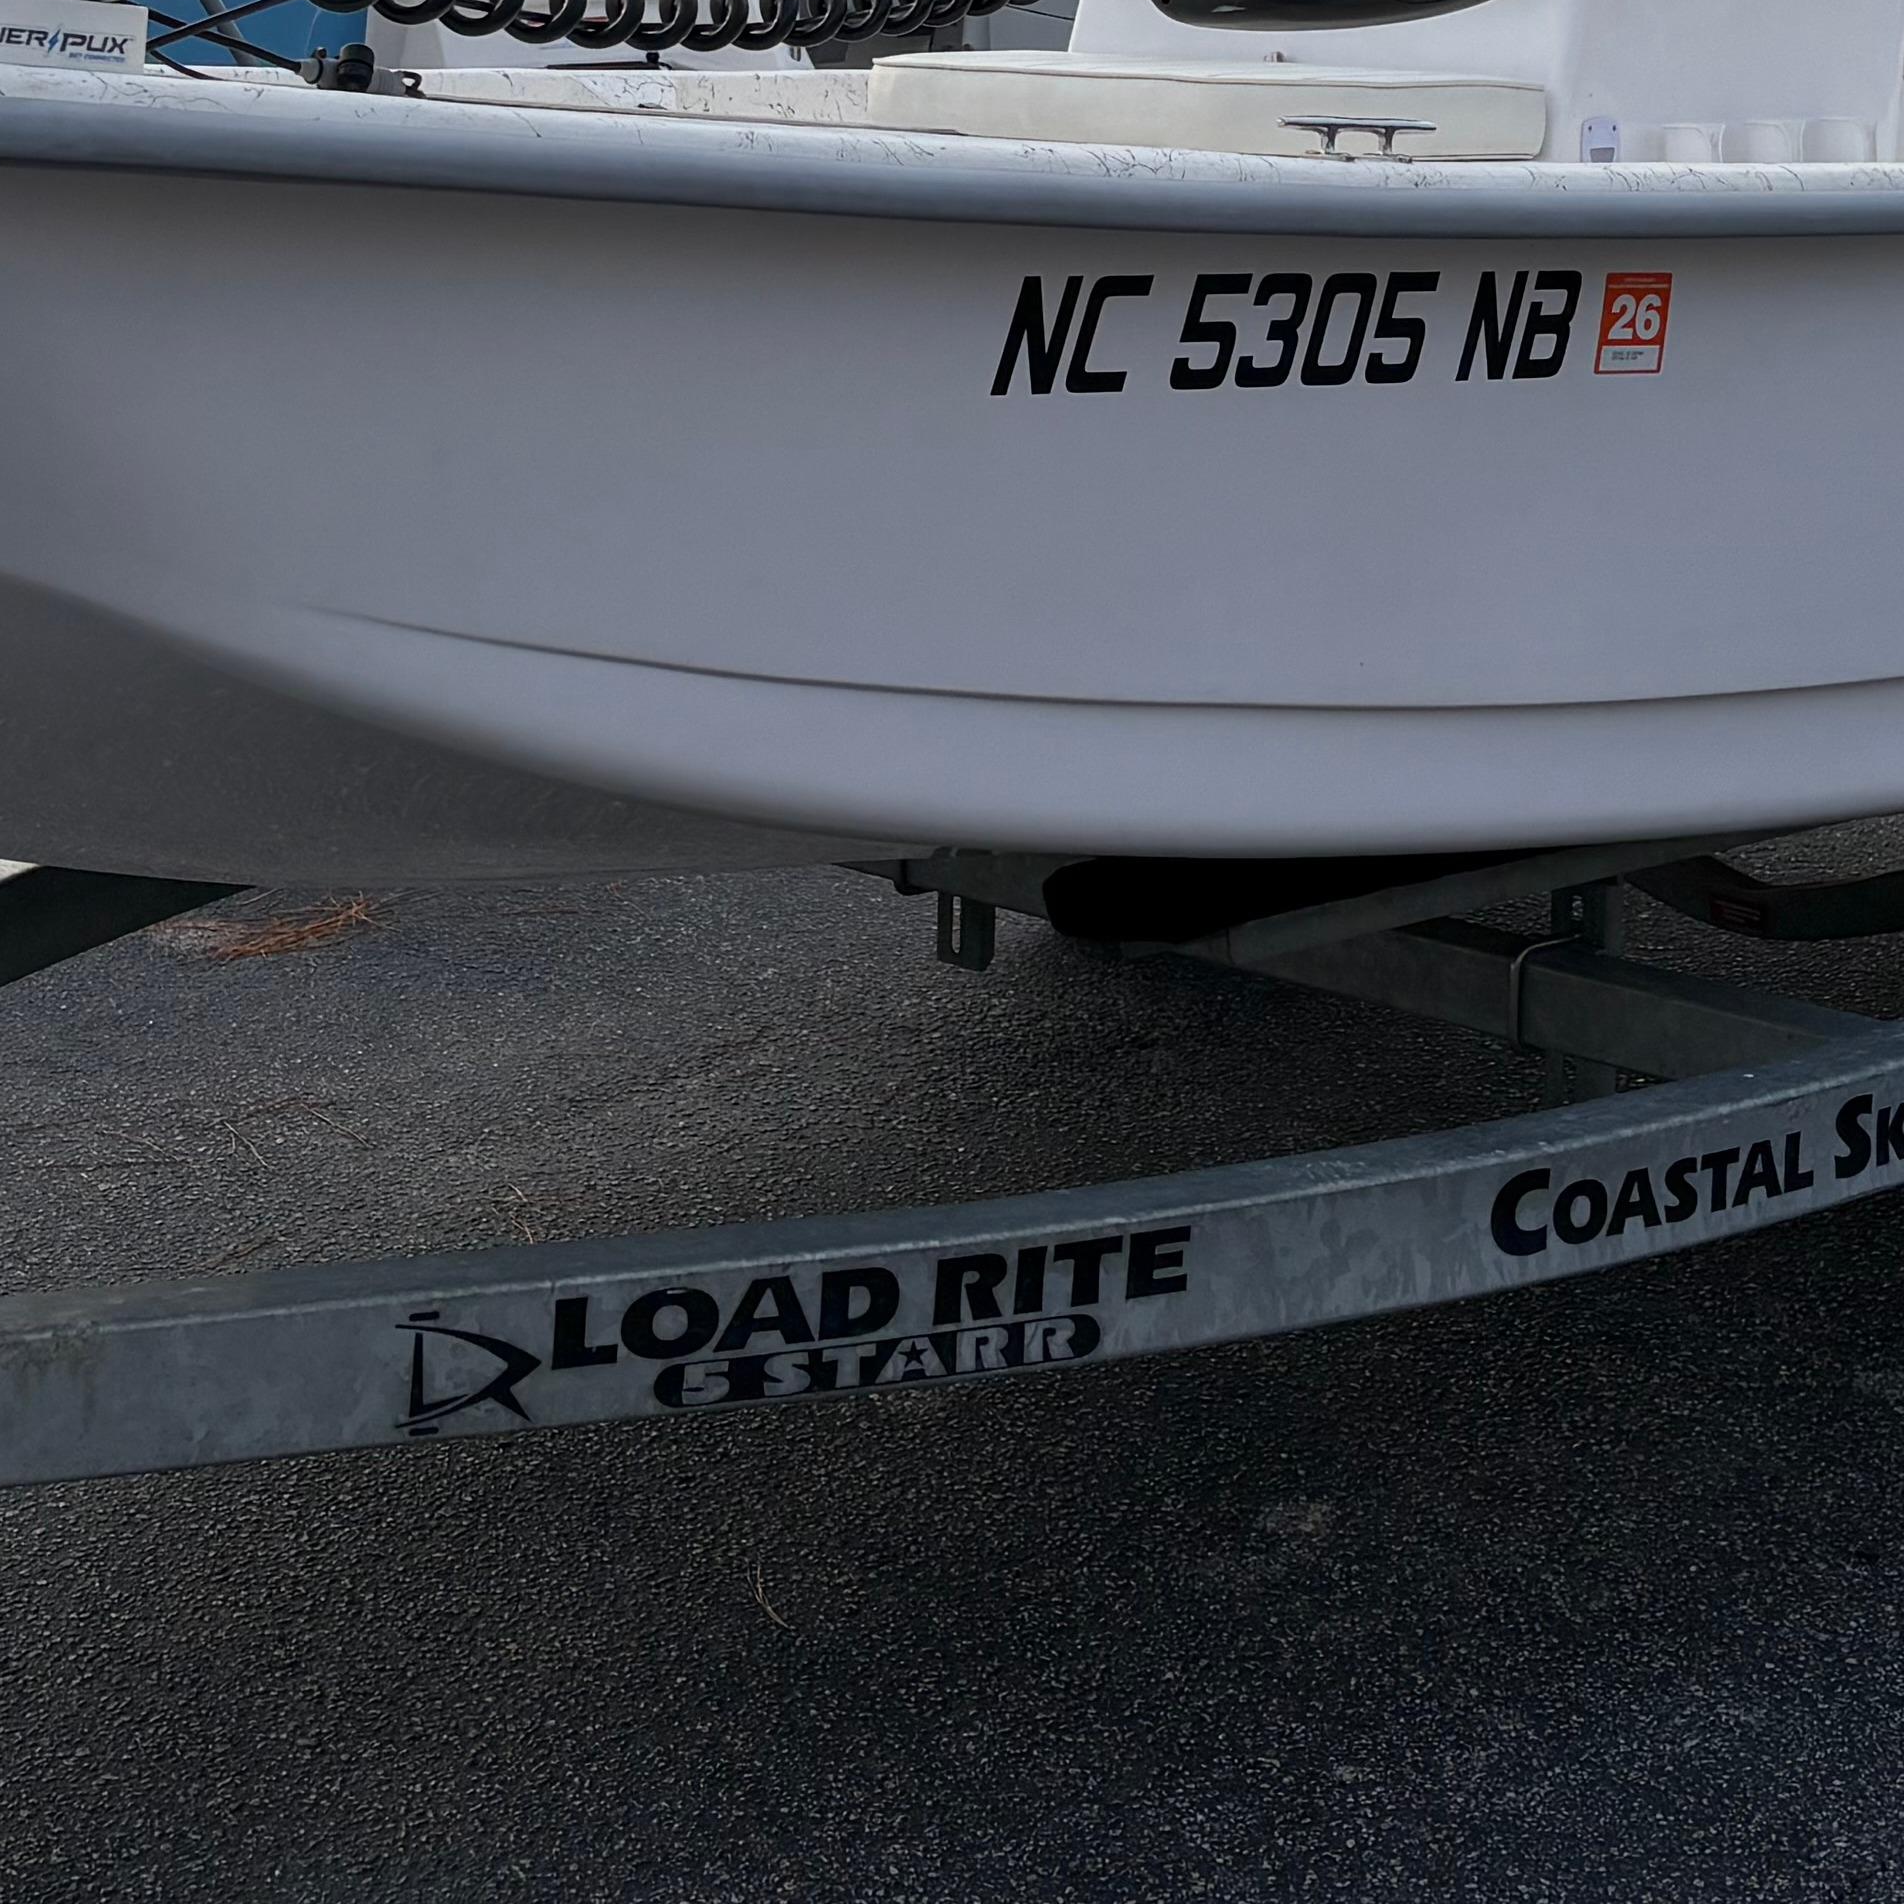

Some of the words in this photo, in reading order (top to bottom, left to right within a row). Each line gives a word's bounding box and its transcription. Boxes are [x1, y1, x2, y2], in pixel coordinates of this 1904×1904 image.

[990, 274, 1155, 396] NC
[1168, 271, 1442, 391] 5305
[1455, 269, 1583, 383] NB
[1608, 294, 1662, 341] 26
[1490, 1130, 1814, 1256] COASTAL
[551, 1265, 901, 1371] LOAD
[932, 1226, 1191, 1327] RITE
[681, 1361, 731, 1406] 5
[763, 1317, 1079, 1398] STARR
